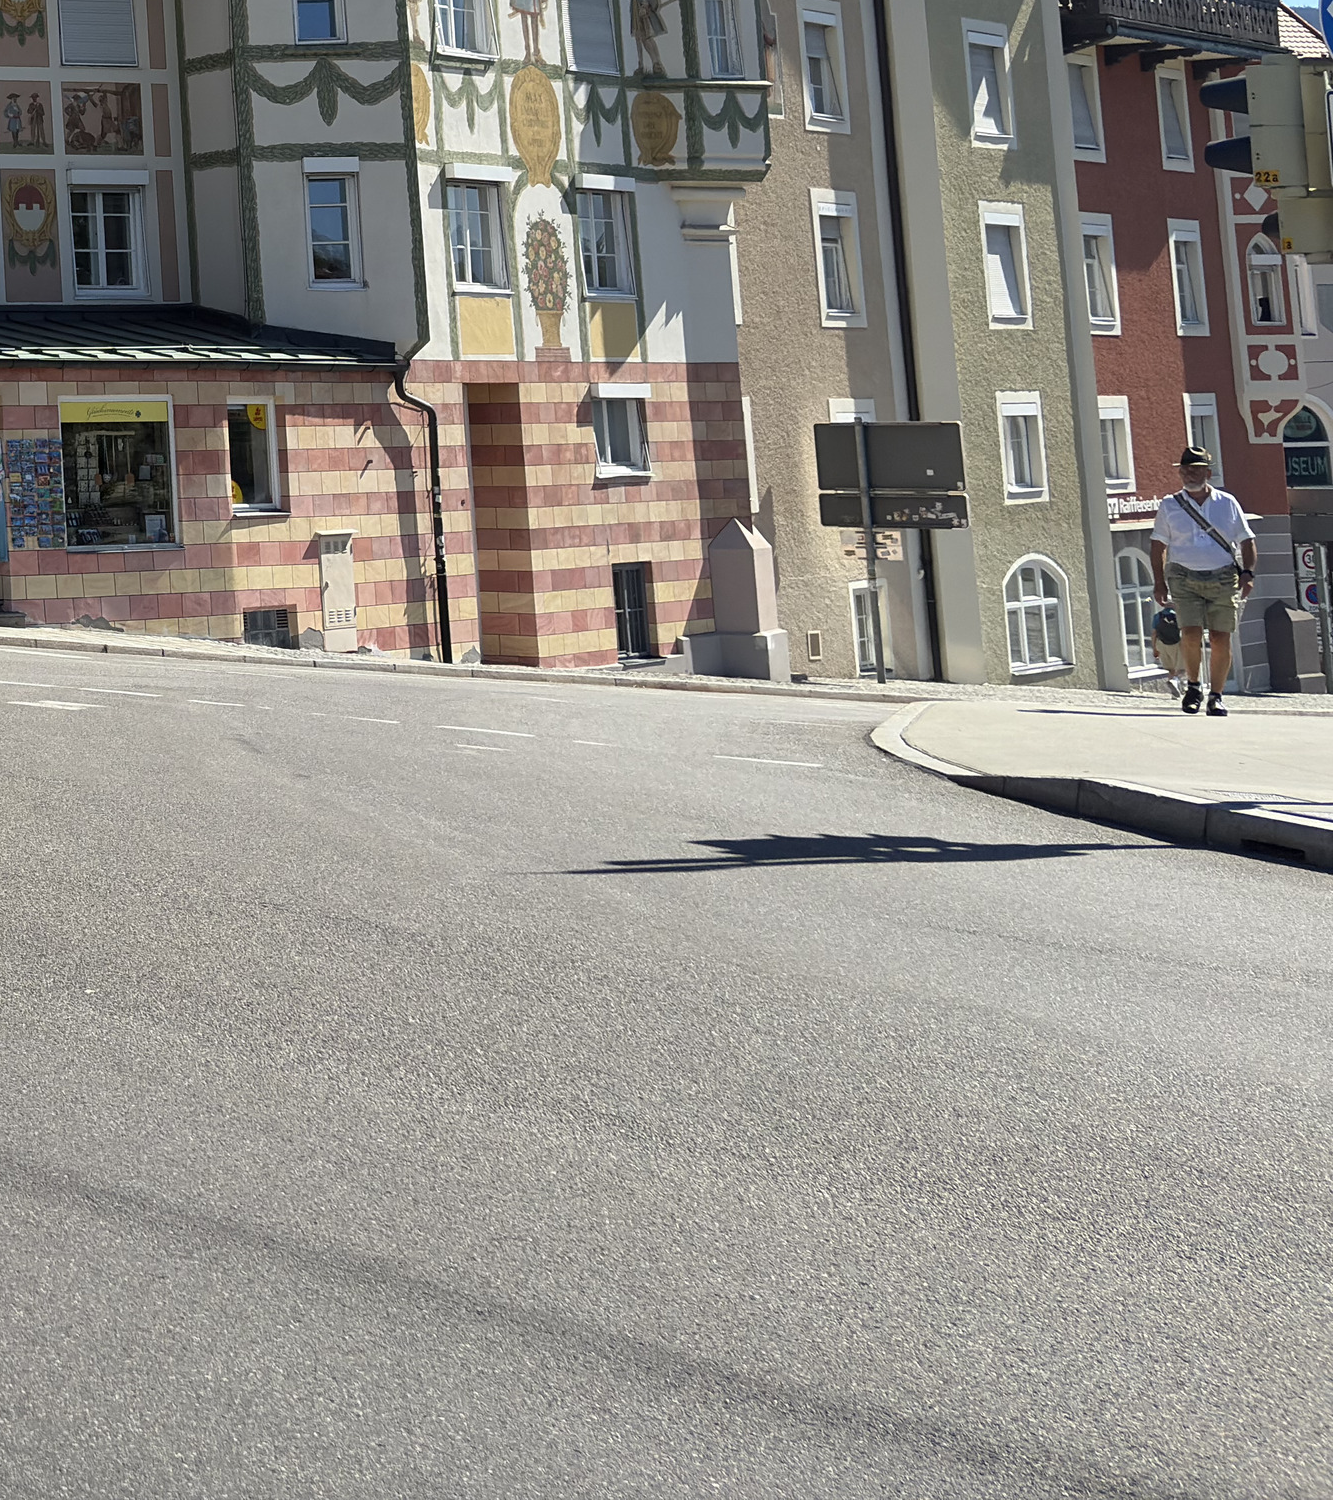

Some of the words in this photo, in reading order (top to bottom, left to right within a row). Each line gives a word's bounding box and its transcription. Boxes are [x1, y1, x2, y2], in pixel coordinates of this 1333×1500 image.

[1255, 172, 1279, 182] 22a
[1287, 456, 1328, 476] USEUM
[1119, 495, 1162, 514] Raiffeisenb
